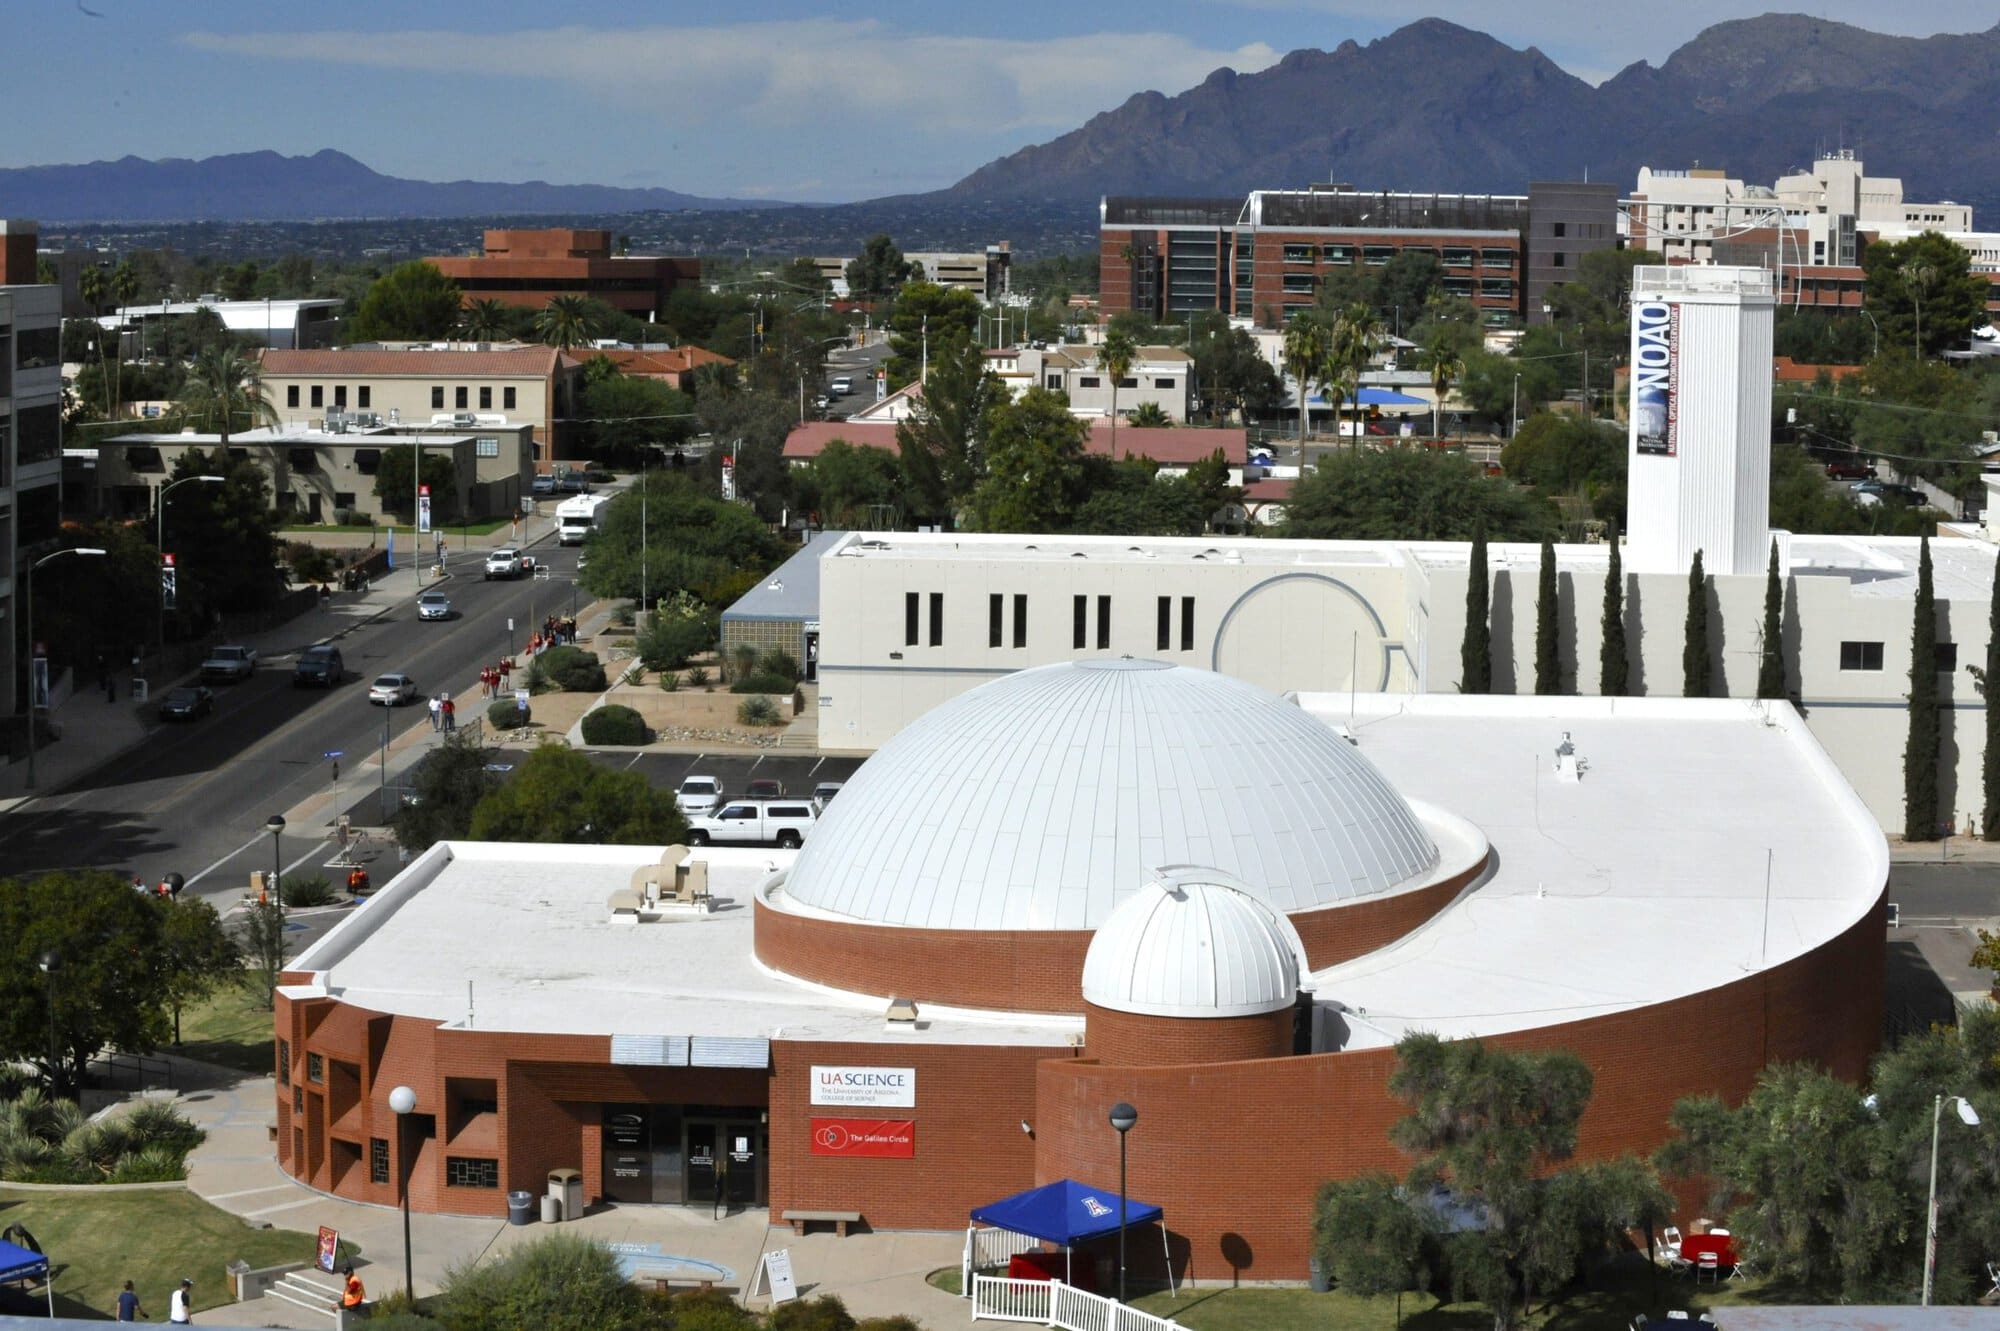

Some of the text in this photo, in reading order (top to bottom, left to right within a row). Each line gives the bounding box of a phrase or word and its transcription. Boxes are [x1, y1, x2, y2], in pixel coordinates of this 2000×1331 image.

[1638, 302, 1671, 390] NOAO
[1668, 306, 1679, 453] NATIONAL OPTICAL ASTRONOMY OBSERVATORY
[850, 1134, 909, 1144] The Galileo Circle
